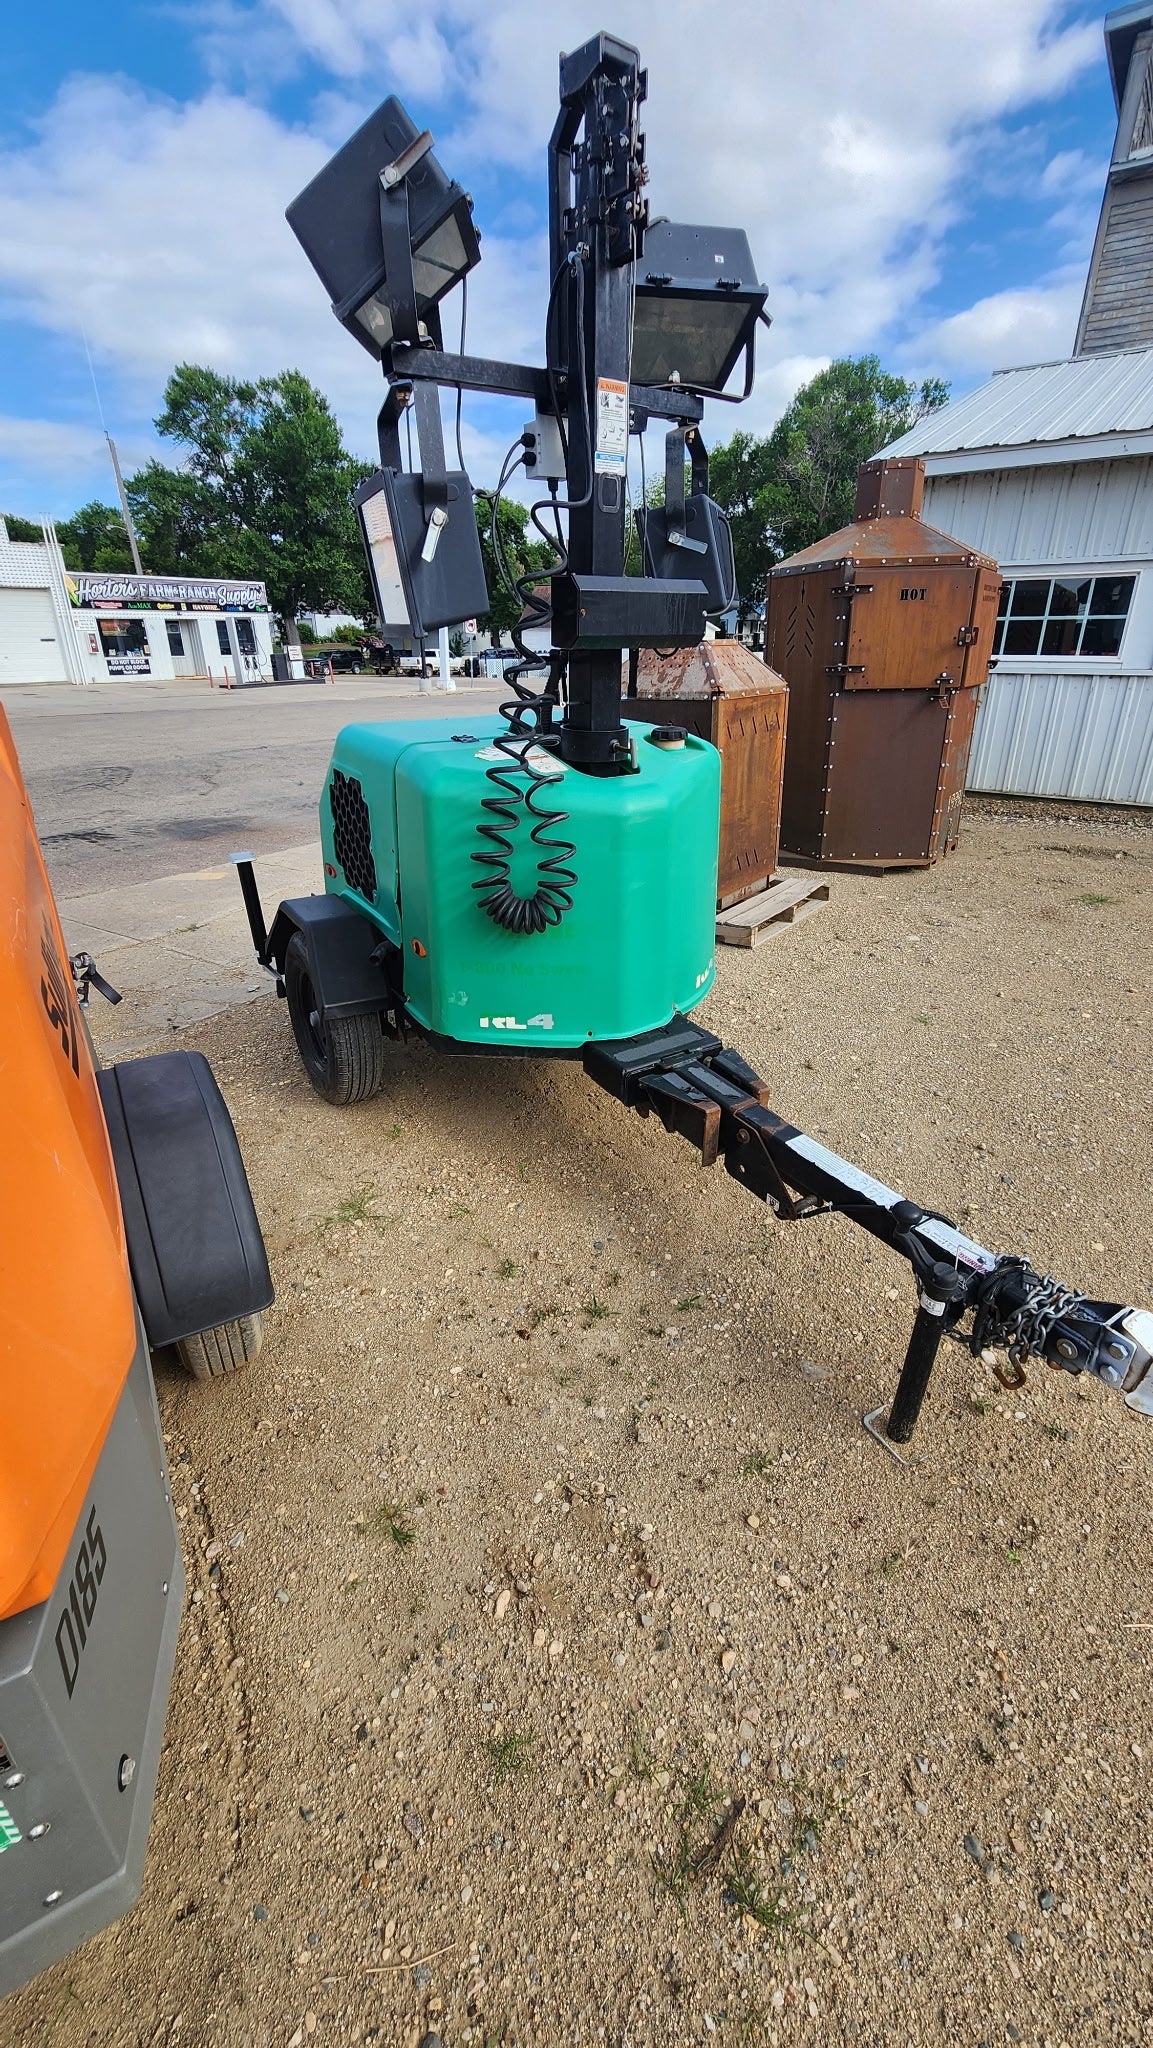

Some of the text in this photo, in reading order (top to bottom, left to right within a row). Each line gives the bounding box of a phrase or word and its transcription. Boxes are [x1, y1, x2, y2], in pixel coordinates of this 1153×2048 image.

[75, 578, 138, 604] Horter's
[138, 583, 174, 598] FARM
[178, 585, 218, 600] RANCH
[217, 585, 260, 609] Supply
[900, 588, 927, 601] HOT
[55, 1503, 107, 1700] D185
